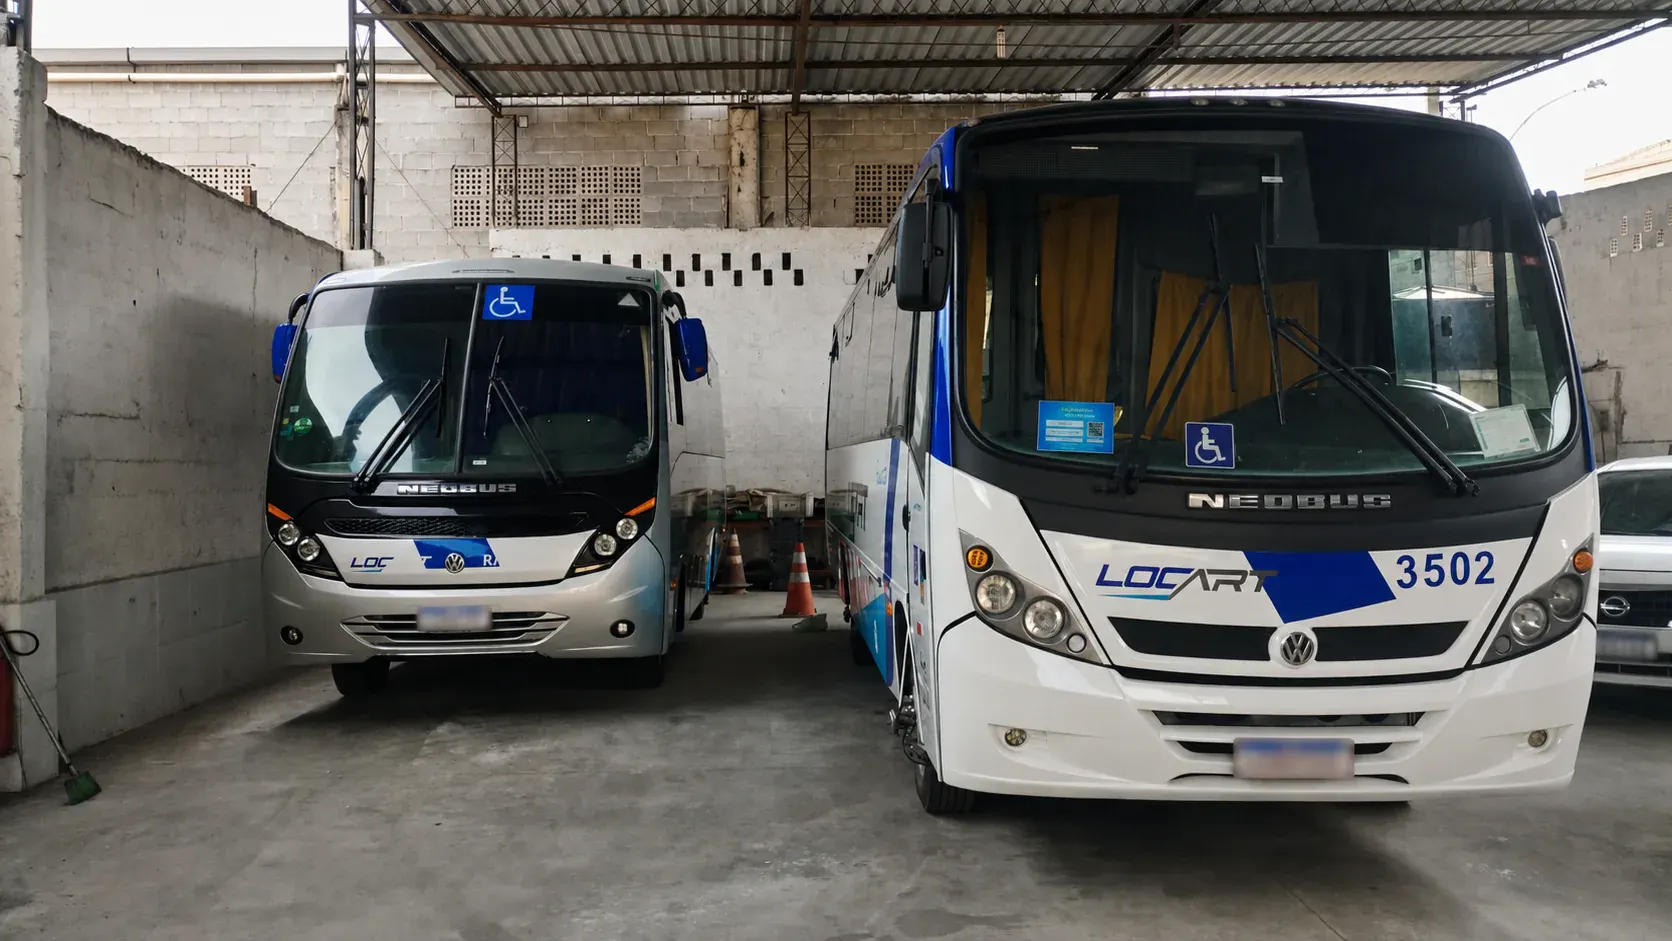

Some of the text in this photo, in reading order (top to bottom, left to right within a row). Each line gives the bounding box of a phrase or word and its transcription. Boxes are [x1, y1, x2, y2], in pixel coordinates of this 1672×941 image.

[397, 483, 517, 495] NEOBUS
[1188, 493, 1392, 509] NEOBUS
[350, 556, 395, 568] LOC
[1396, 550, 1495, 589] 3502
[1095, 563, 1279, 601] LOCART
